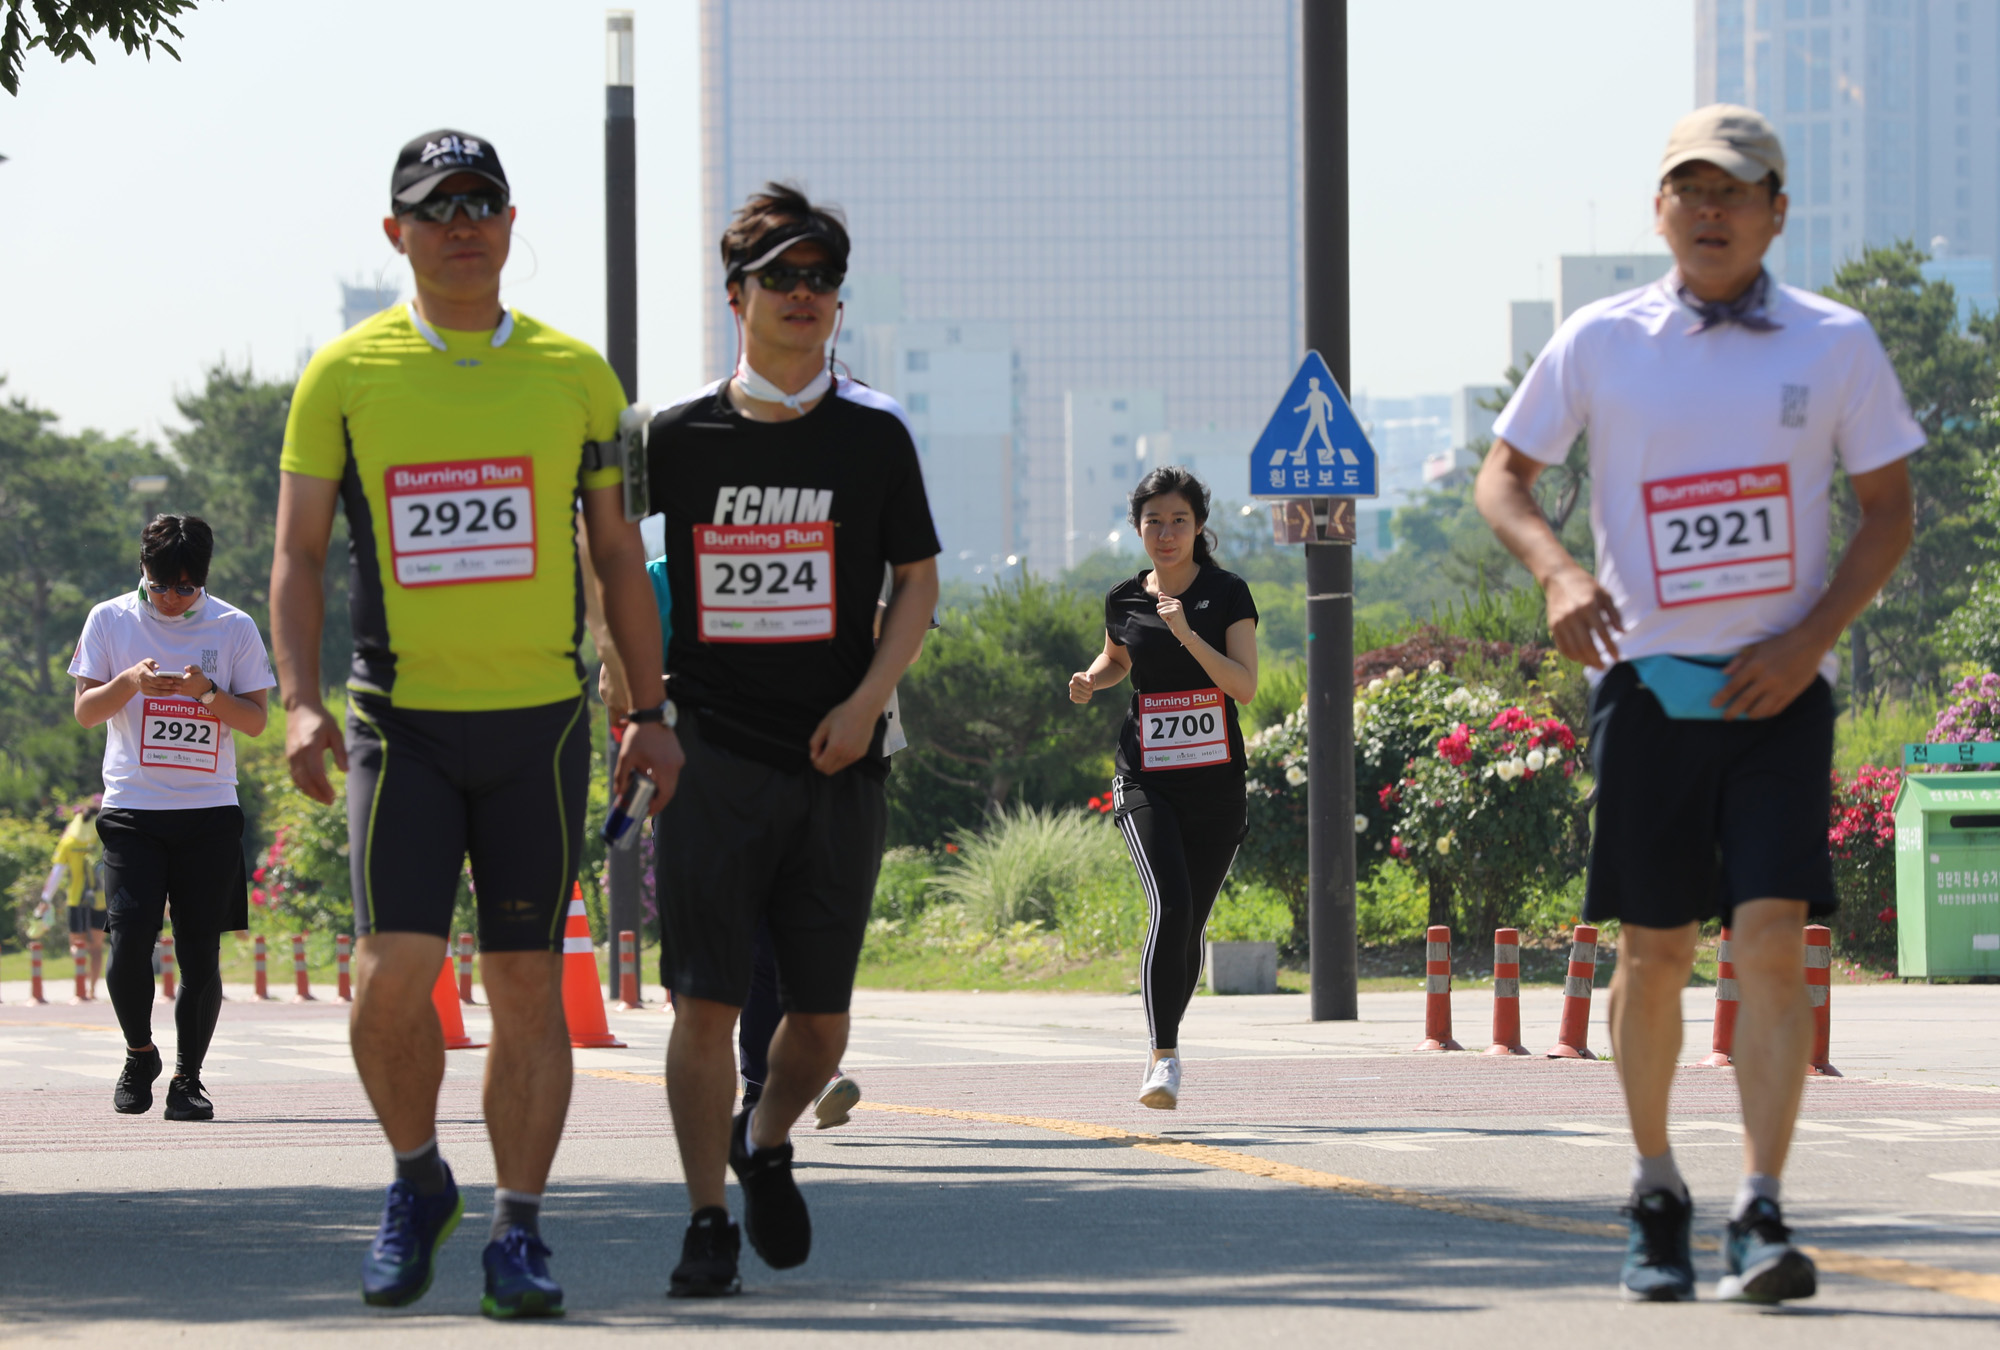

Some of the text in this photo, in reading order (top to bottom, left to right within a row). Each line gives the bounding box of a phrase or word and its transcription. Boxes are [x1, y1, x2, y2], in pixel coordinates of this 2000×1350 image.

[394, 464, 523, 487] Burning Run
[1269, 469, 1360, 488] 횡단보도
[1651, 473, 1781, 504] Burning Run
[408, 496, 517, 538] 2926
[712, 485, 834, 526] FCMM
[703, 529, 823, 548] Burning Run
[1666, 507, 1771, 554] 2921
[714, 560, 817, 595] 2924
[201, 656, 217, 664] SKY
[201, 665, 217, 673] RUN
[149, 702, 195, 715] Burning
[197, 706, 213, 716] Ru
[1144, 693, 1217, 707] Burning Run
[152, 720, 211, 744] 2922
[1150, 712, 1215, 740] 2700
